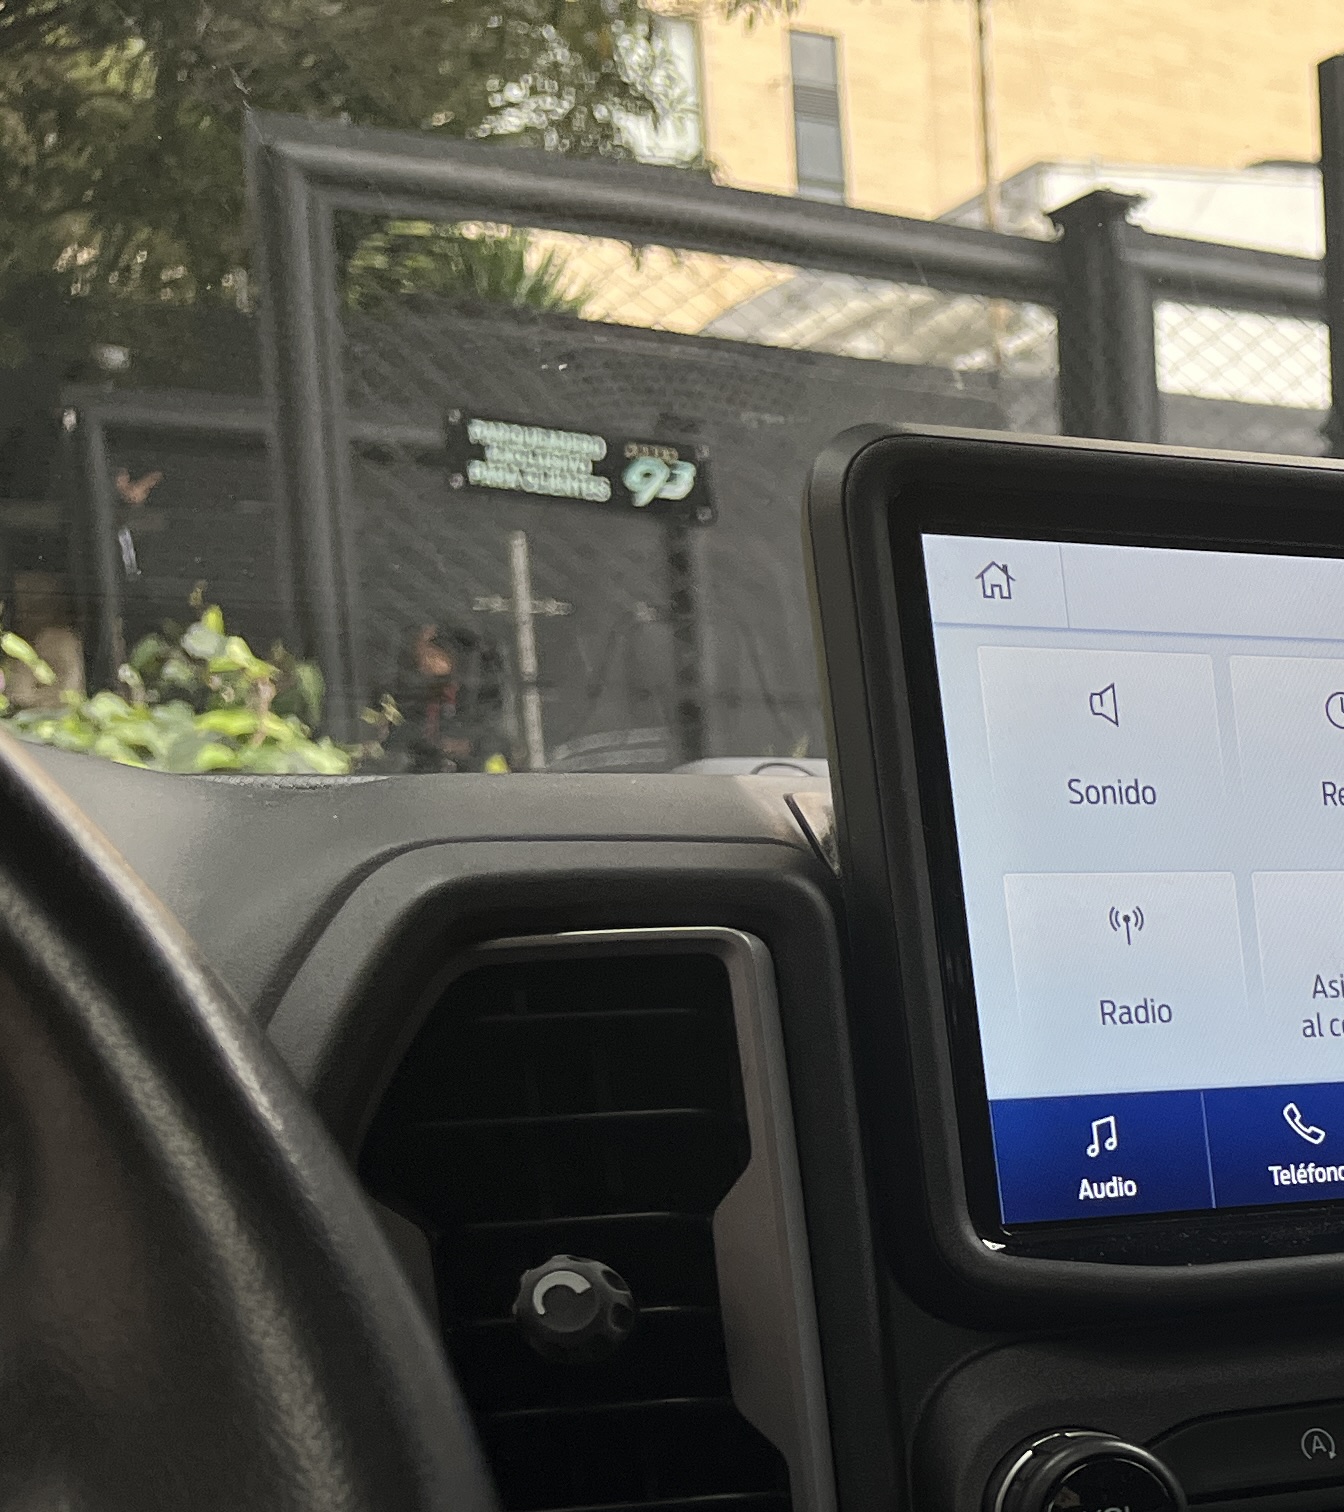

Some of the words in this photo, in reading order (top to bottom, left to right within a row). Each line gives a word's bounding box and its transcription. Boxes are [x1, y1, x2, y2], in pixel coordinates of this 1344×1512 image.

[1067, 777, 1158, 806] Sonido
[1099, 998, 1173, 1026] Radio
[1301, 1013, 1325, 1039] al
[1078, 1175, 1138, 1200] Audio
